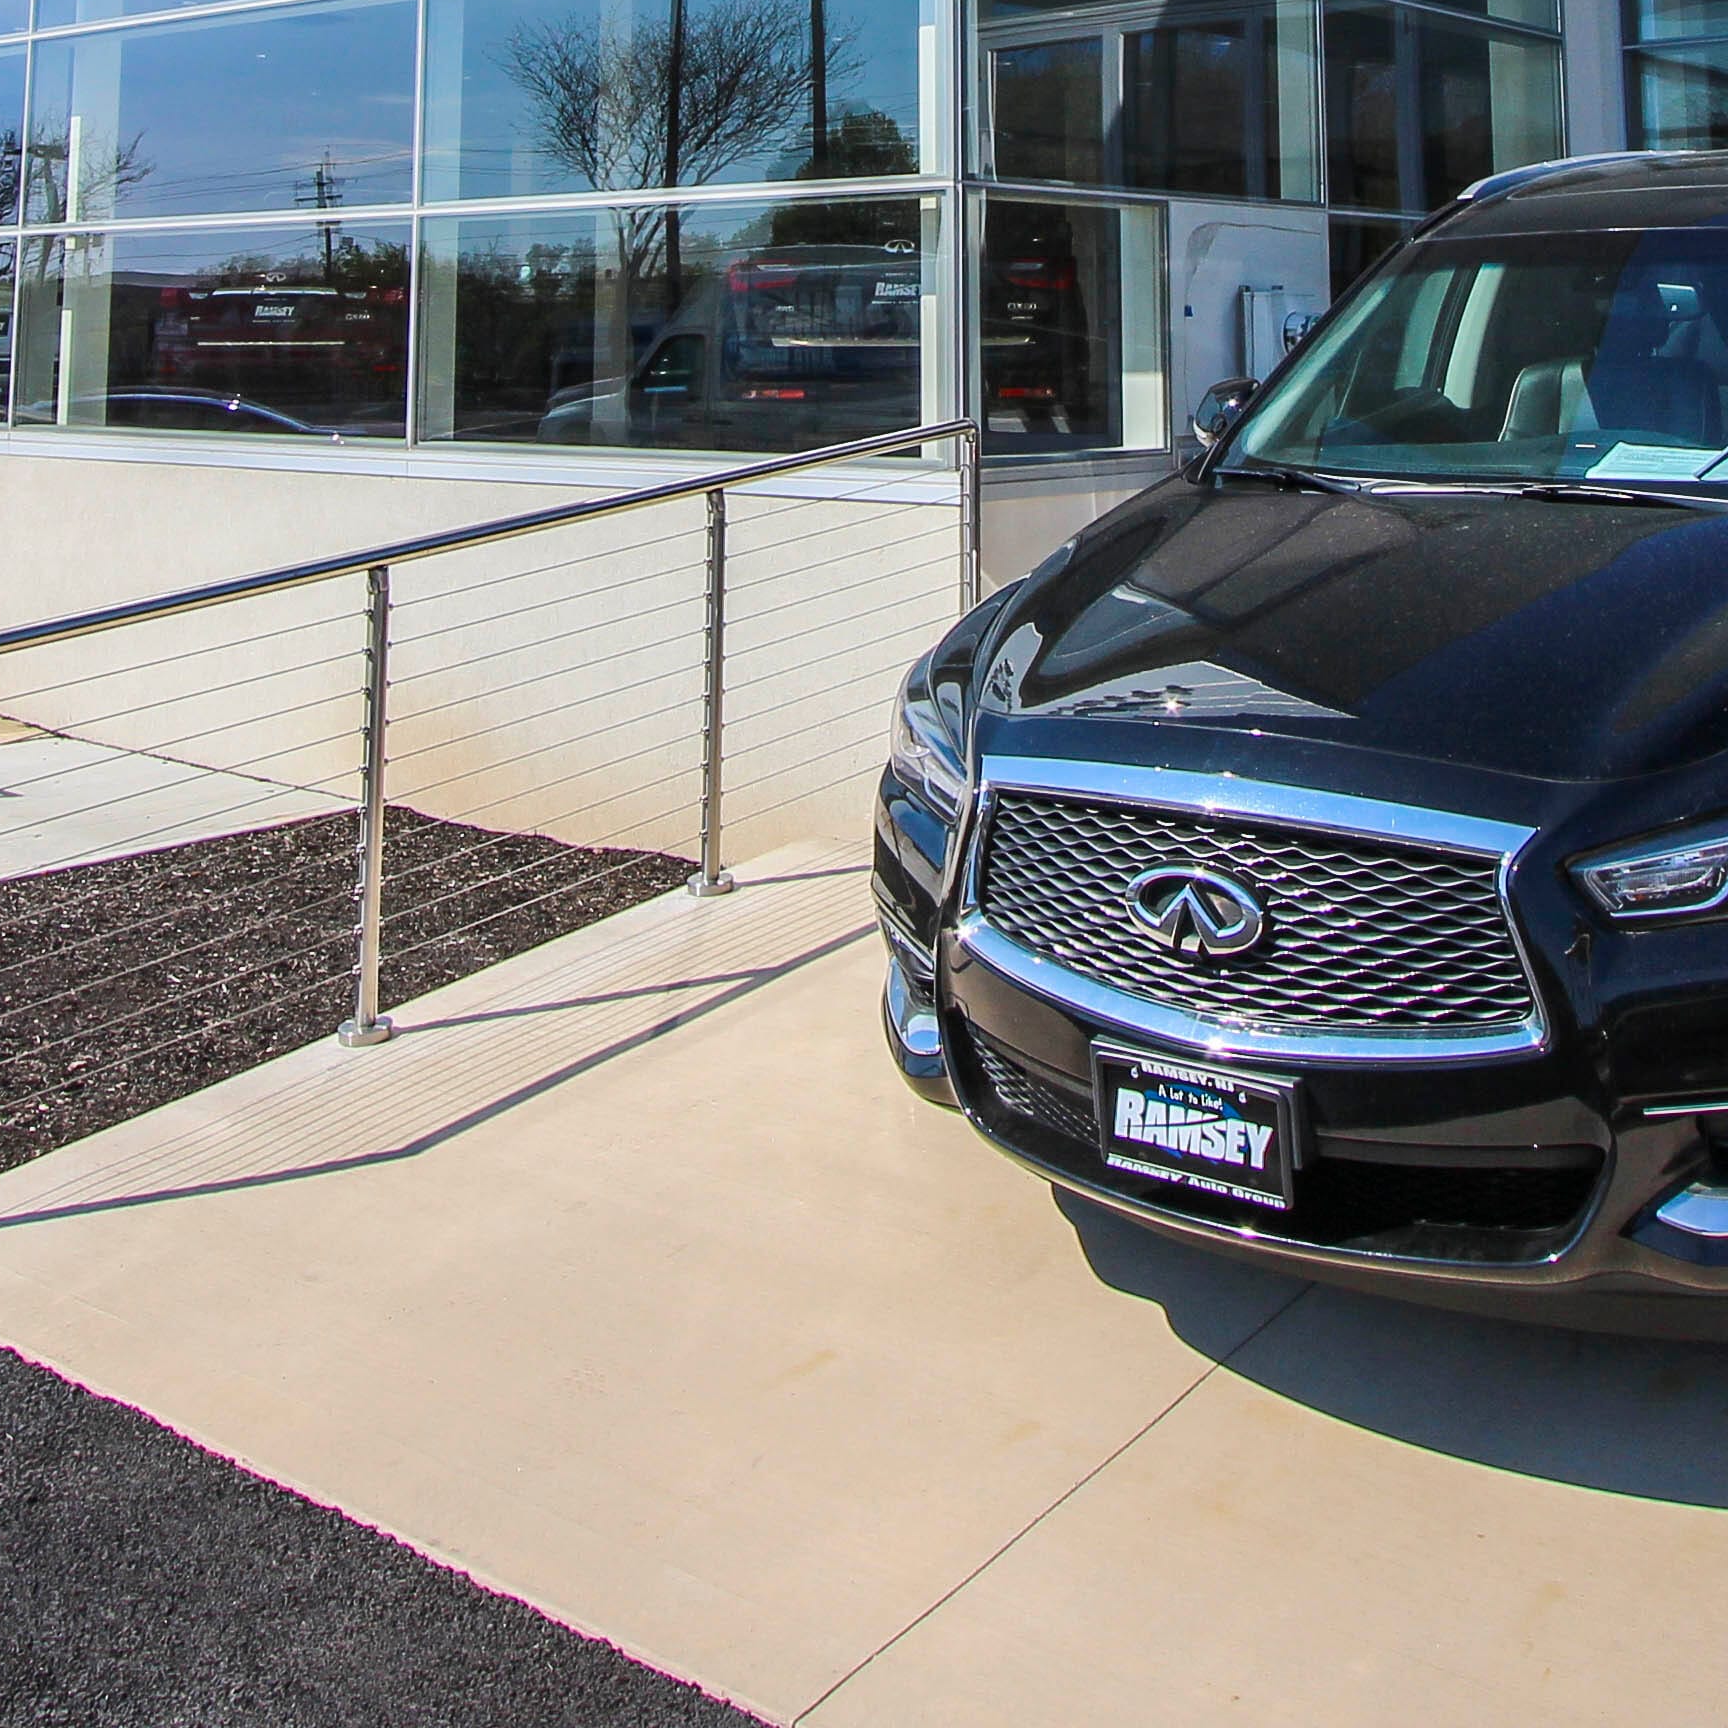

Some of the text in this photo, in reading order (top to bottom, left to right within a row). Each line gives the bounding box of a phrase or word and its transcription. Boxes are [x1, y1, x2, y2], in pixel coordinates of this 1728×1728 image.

[1158, 1083, 1167, 1098] A
[1188, 1091, 1199, 1105] to
[1114, 1087, 1273, 1169] RAMSEY
[1187, 1176, 1228, 1195] Auto
